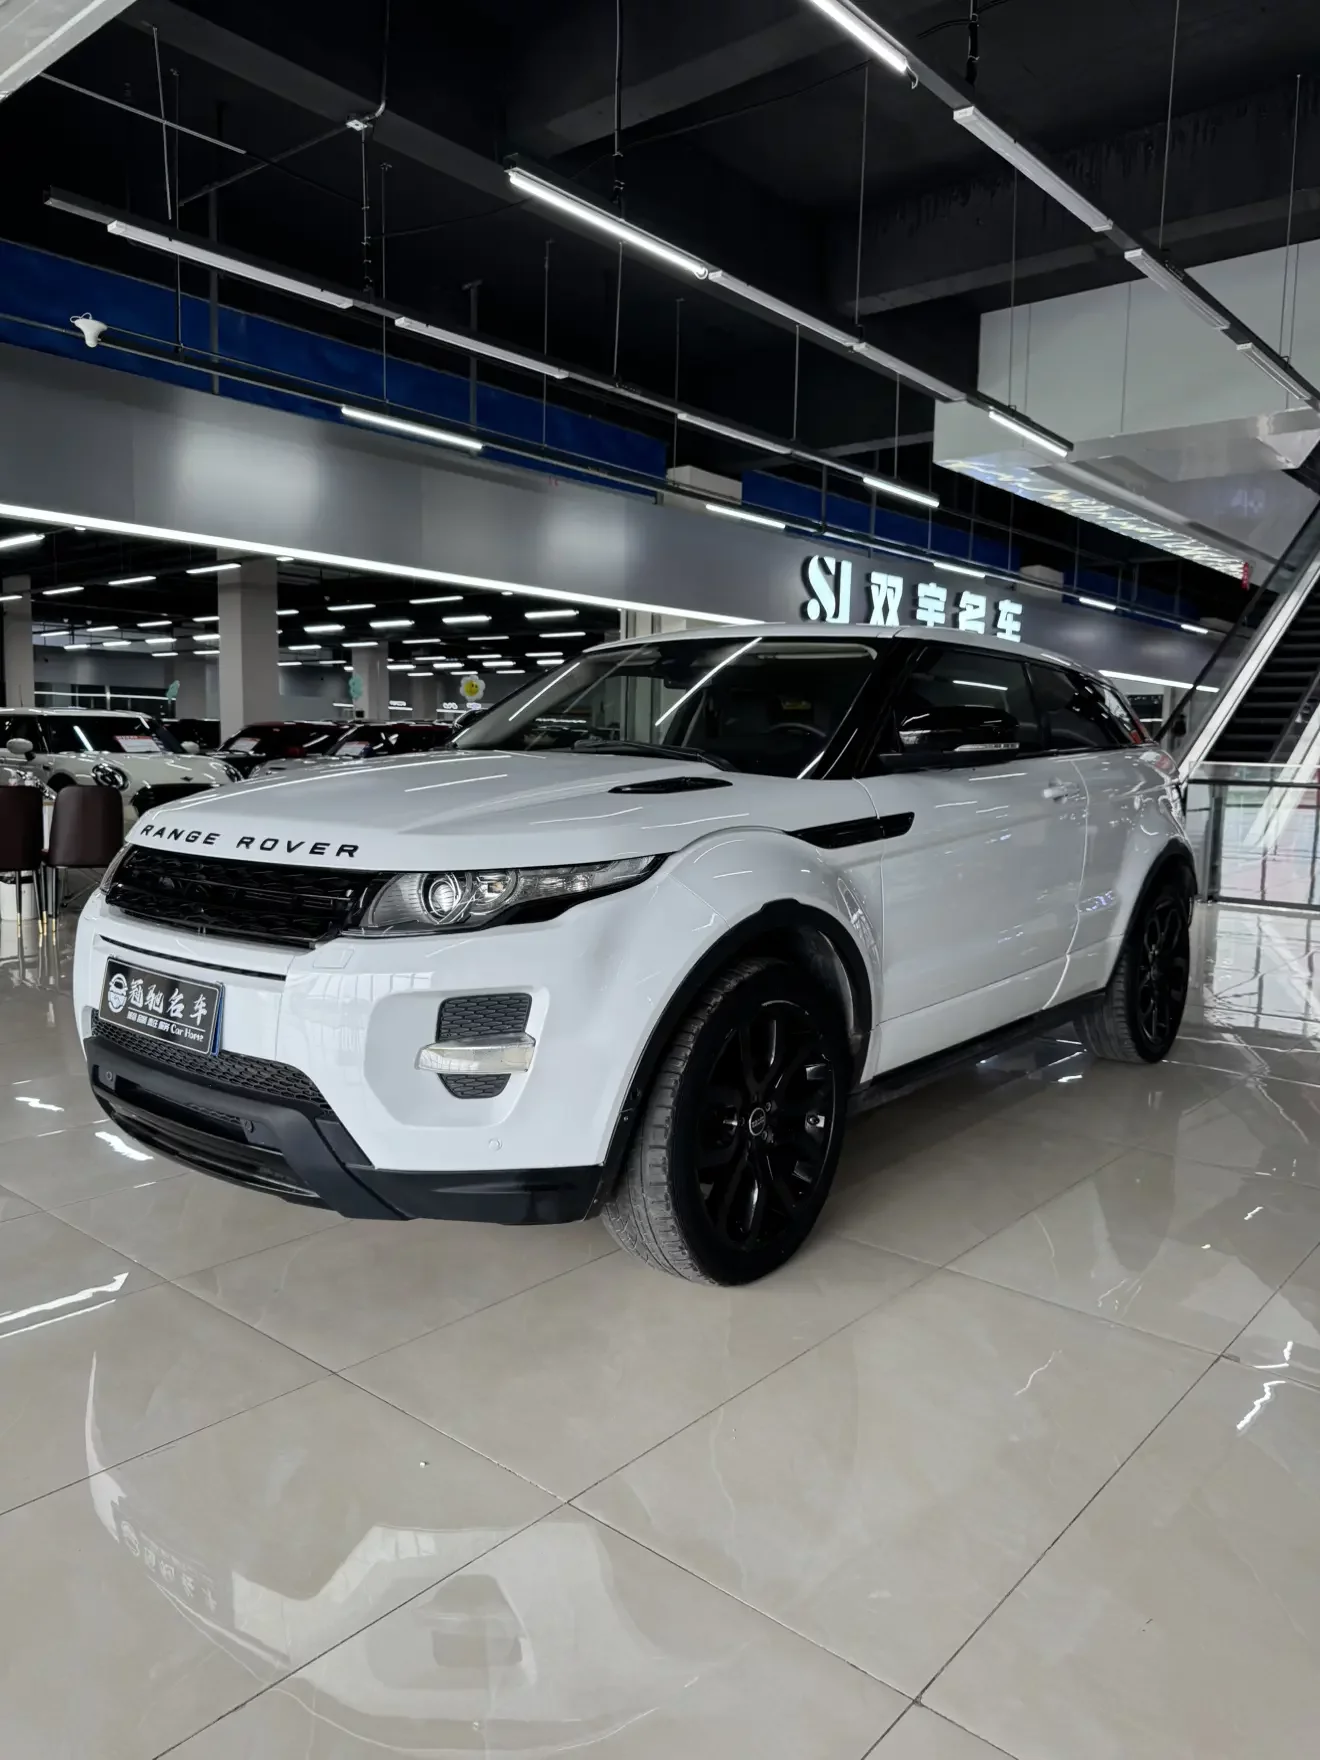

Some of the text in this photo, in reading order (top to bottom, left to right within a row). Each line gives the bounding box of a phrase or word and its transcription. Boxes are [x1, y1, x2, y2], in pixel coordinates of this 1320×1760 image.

[140, 824, 359, 858] RANGE ROVER
[170, 1023, 184, 1036] Car
